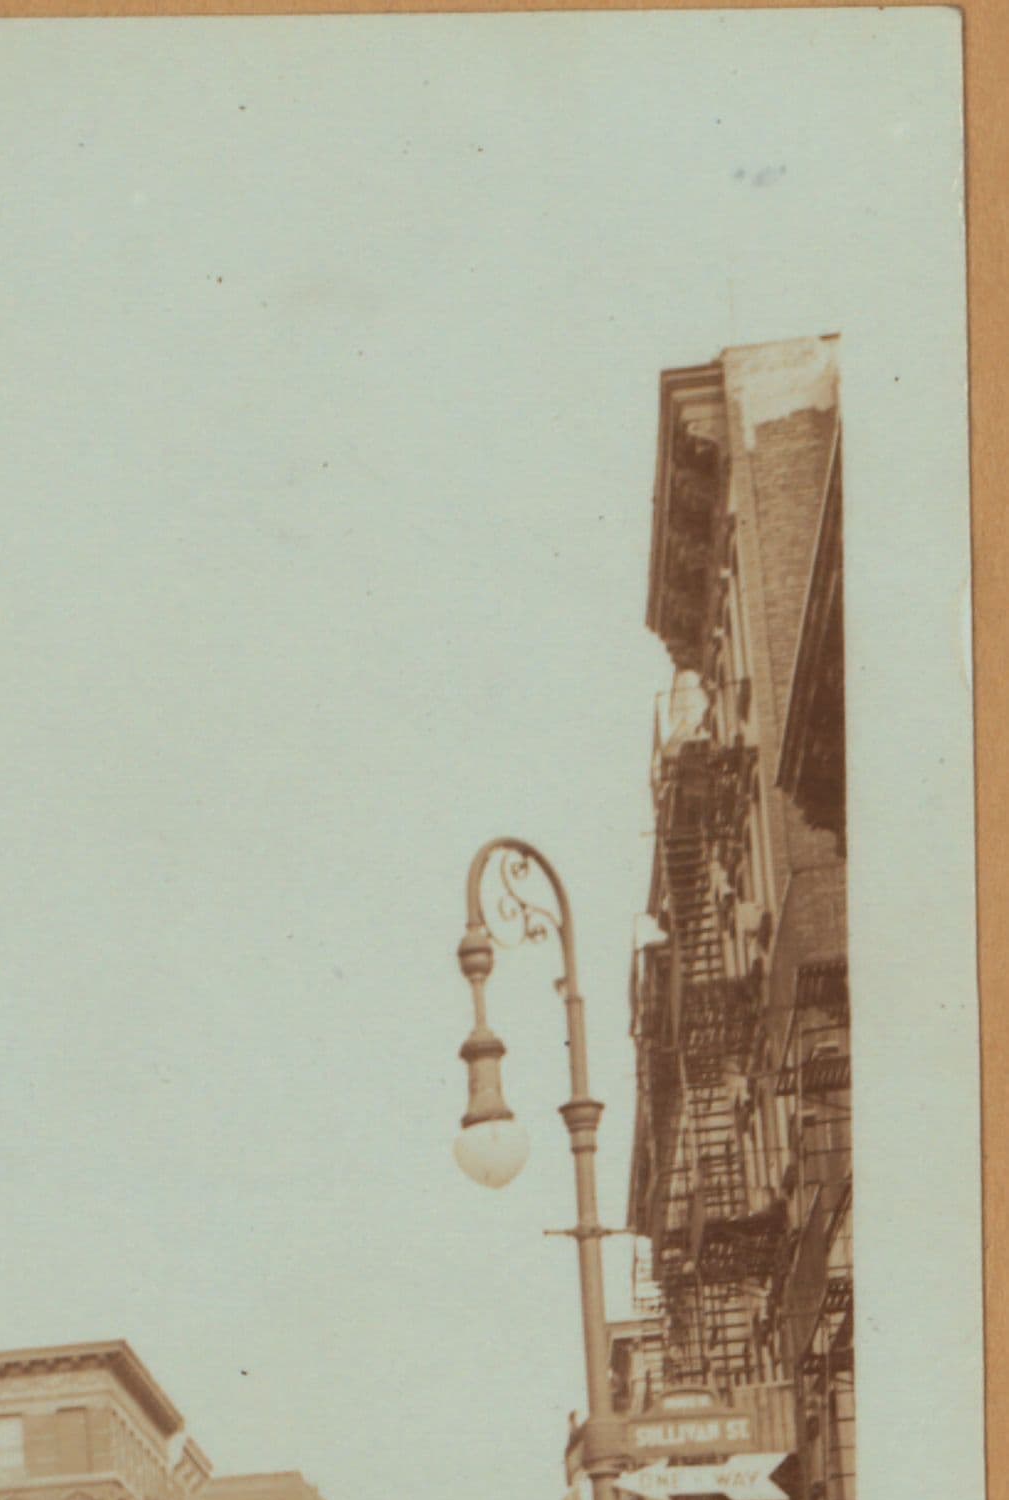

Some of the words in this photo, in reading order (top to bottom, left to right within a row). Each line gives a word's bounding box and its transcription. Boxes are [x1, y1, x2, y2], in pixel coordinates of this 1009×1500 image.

[635, 1421, 719, 1447] SULLIVAN
[639, 1473, 679, 1490] ONE
[712, 1471, 759, 1488] WAY
